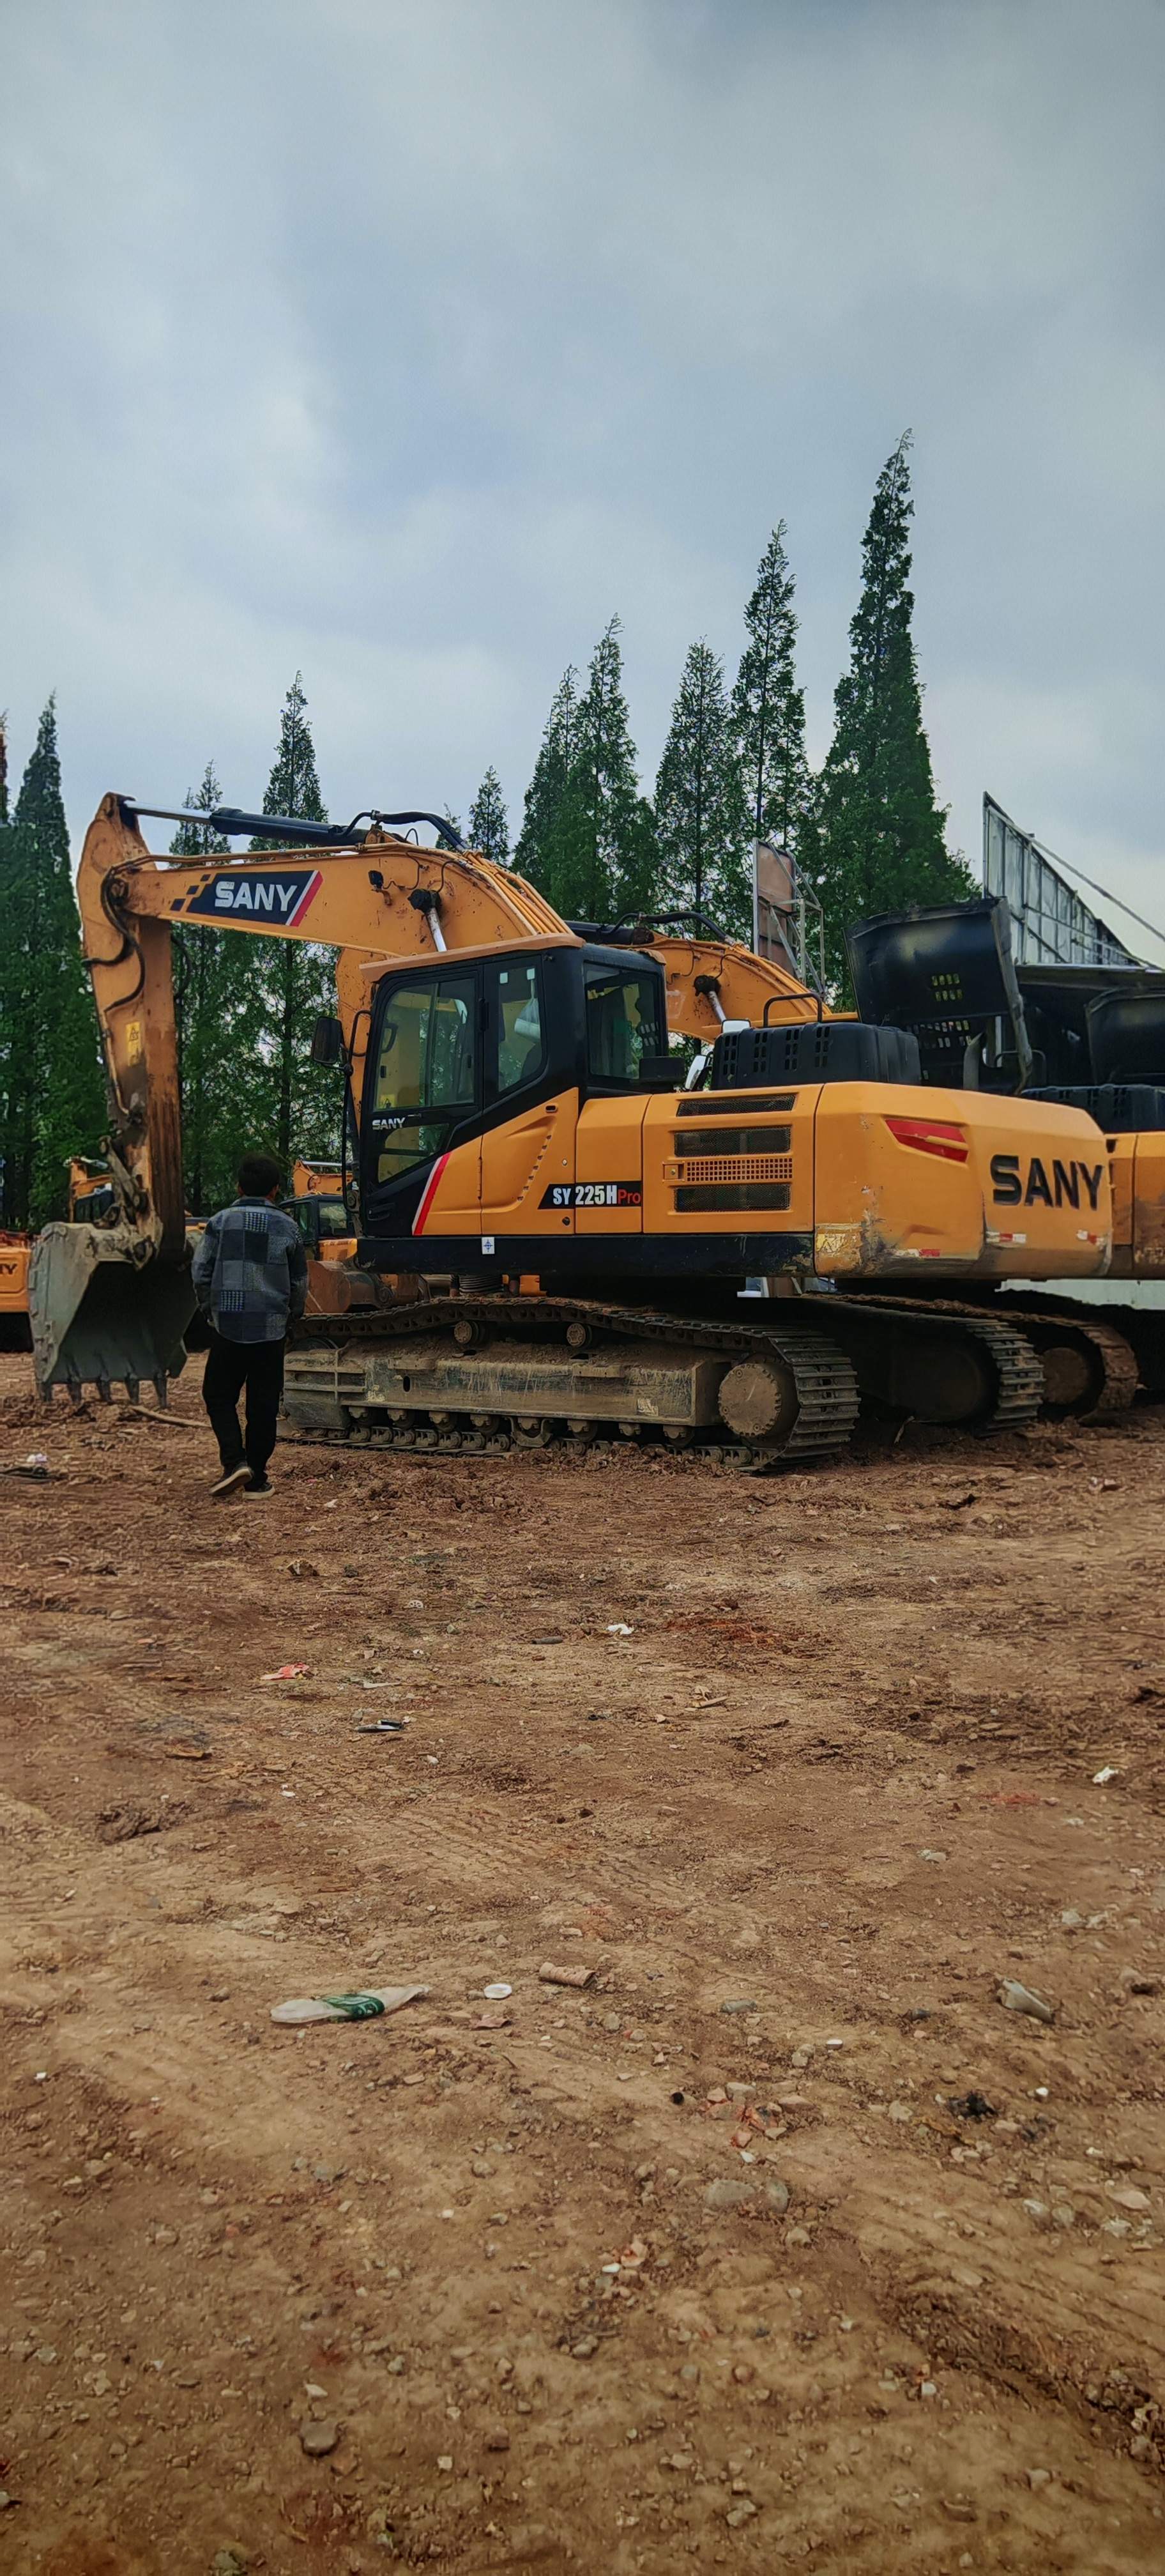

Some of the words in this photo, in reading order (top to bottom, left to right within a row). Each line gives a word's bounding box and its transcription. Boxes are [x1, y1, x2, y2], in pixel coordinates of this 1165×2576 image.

[215, 881, 298, 912] SANY
[372, 1117, 406, 1130] SANY
[991, 1154, 1104, 1211] SANY
